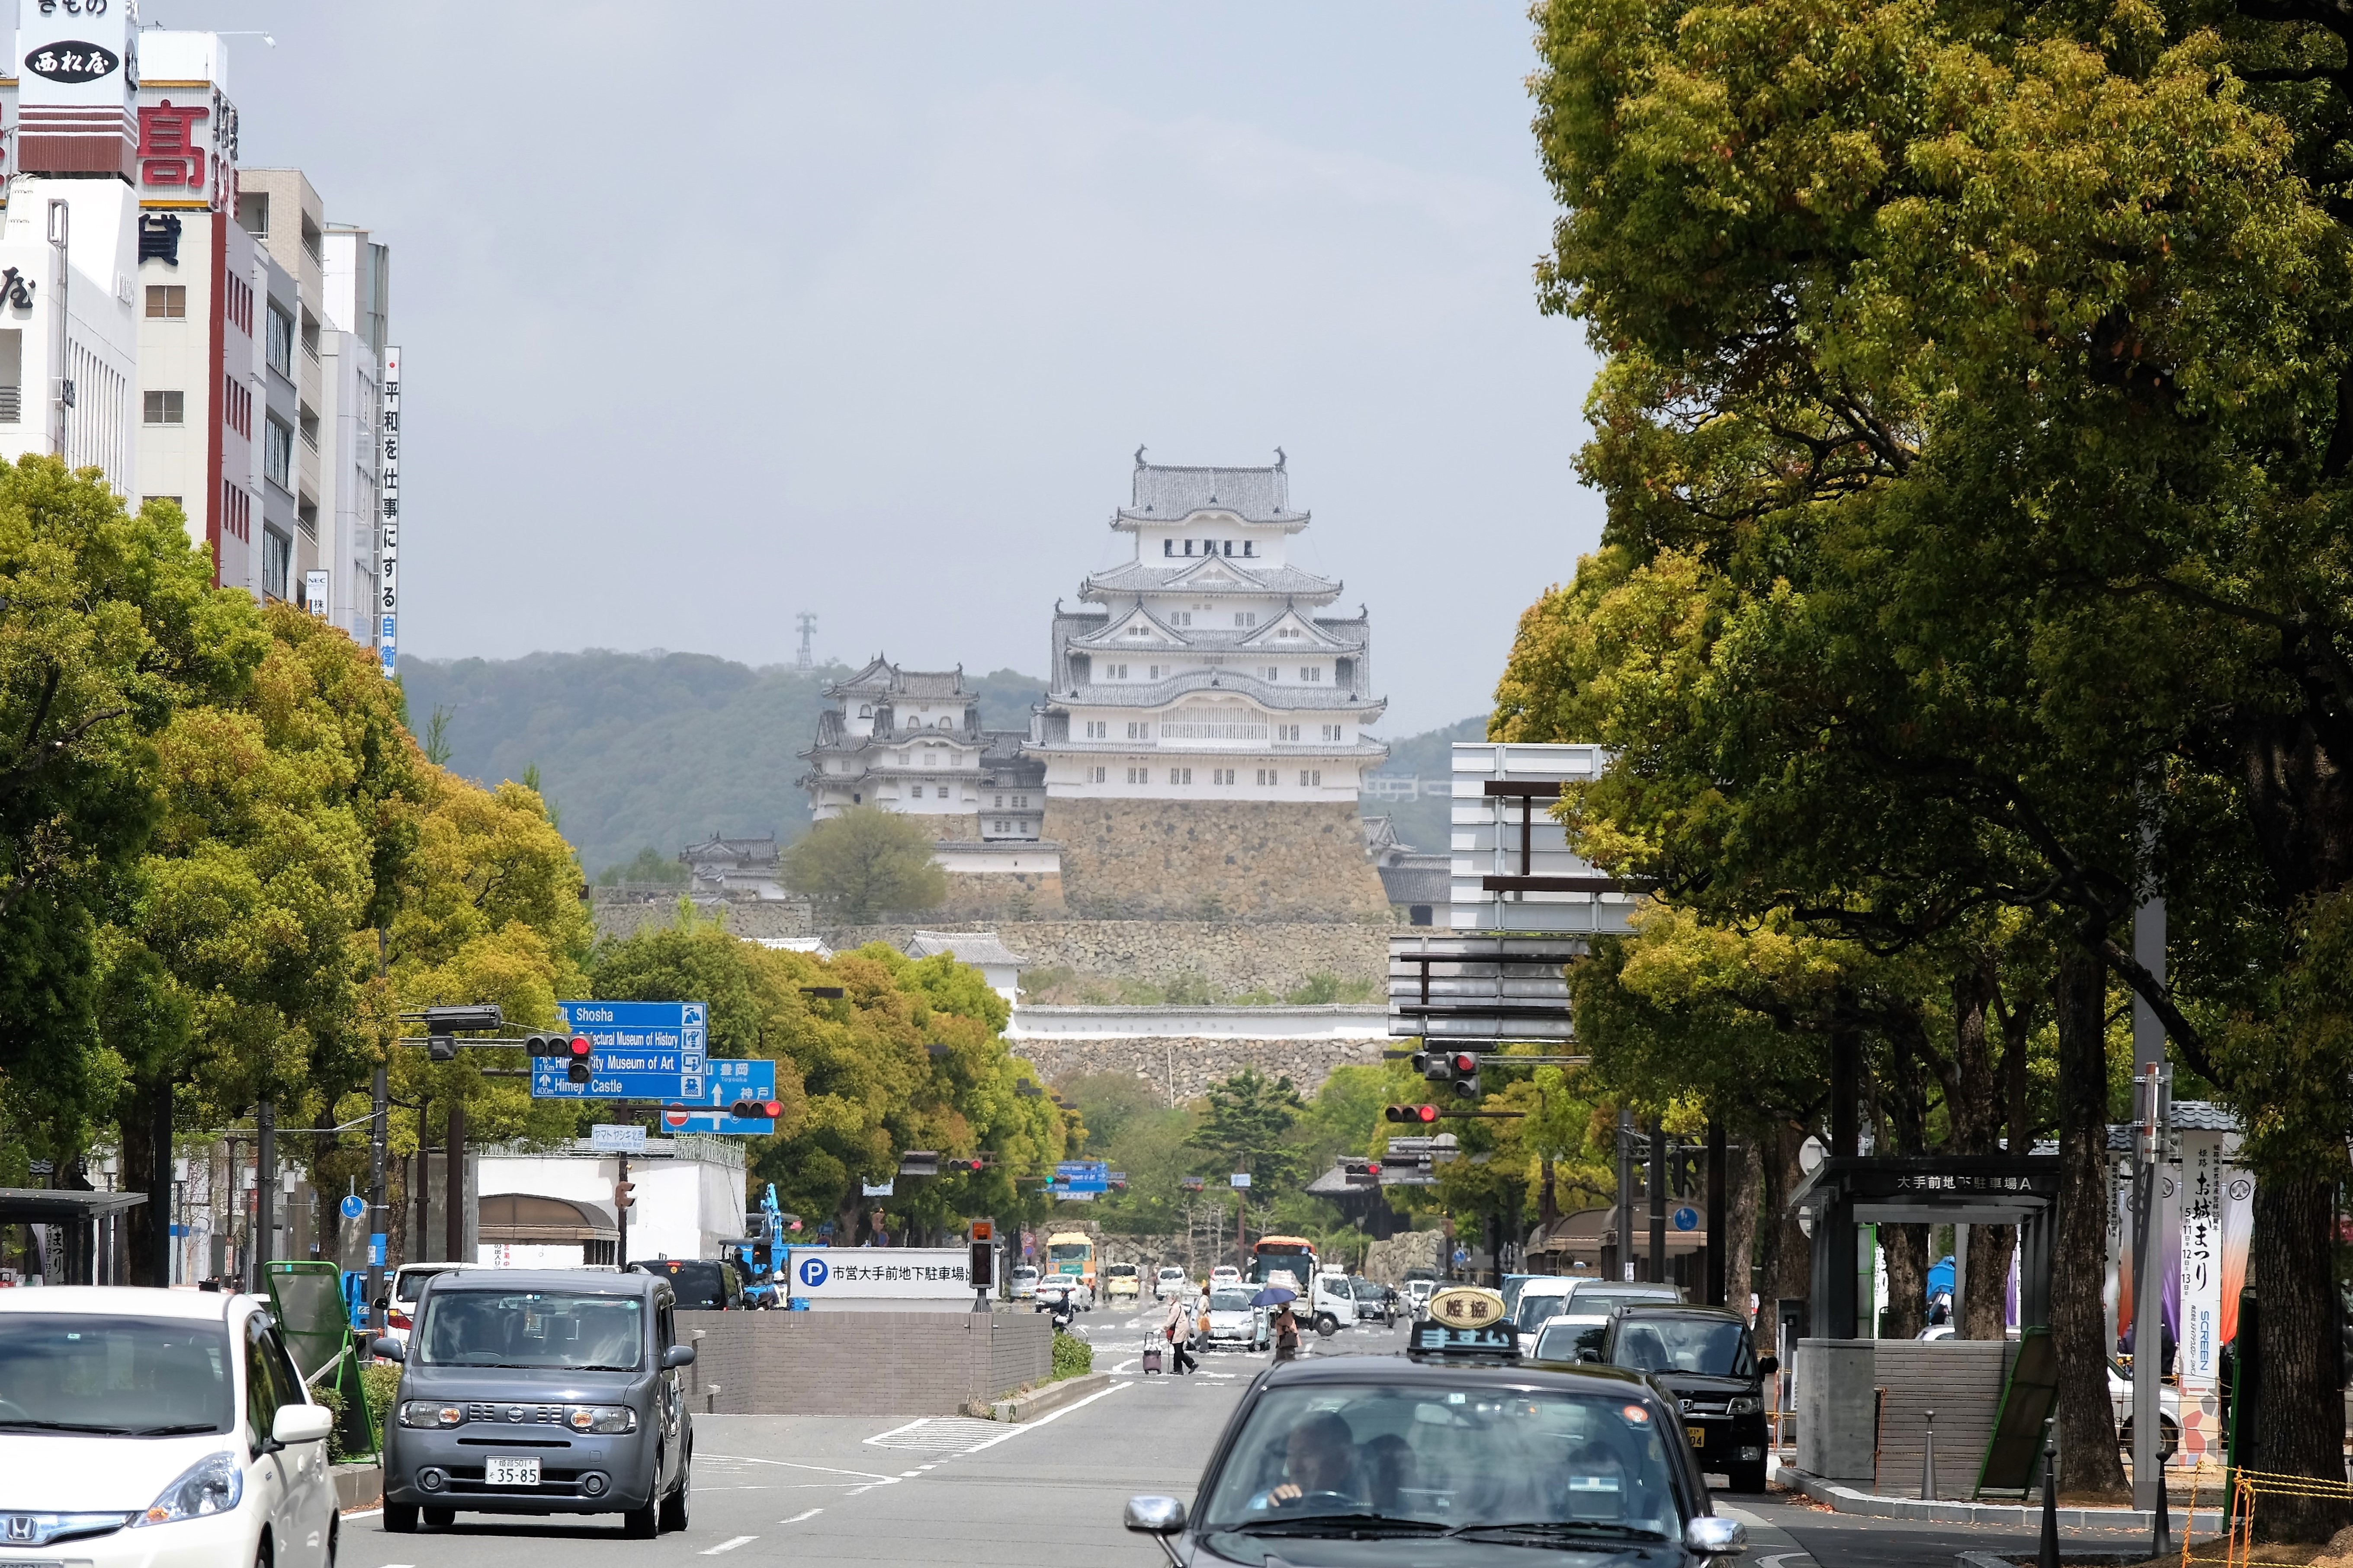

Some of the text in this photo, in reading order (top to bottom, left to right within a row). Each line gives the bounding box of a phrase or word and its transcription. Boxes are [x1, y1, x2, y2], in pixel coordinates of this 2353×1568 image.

[35, 51, 109, 74] 西松屋
[381, 381, 398, 680] 平和を仕事にする 自衛
[576, 1007, 613, 1022] Shosha
[617, 1031, 644, 1046] Museum
[646, 1032, 653, 1046] of
[655, 1032, 678, 1049] History
[608, 1055, 644, 1070] Museum
[648, 1055, 658, 1070] of
[661, 1056, 674, 1070] Art
[720, 1063, 748, 1076] 豊岡
[591, 1079, 622, 1093] Castle
[740, 1087, 769, 1100] 神戸
[2200, 1311, 2209, 1371] SCREEN
[497, 1468, 536, 1483] 35-85
